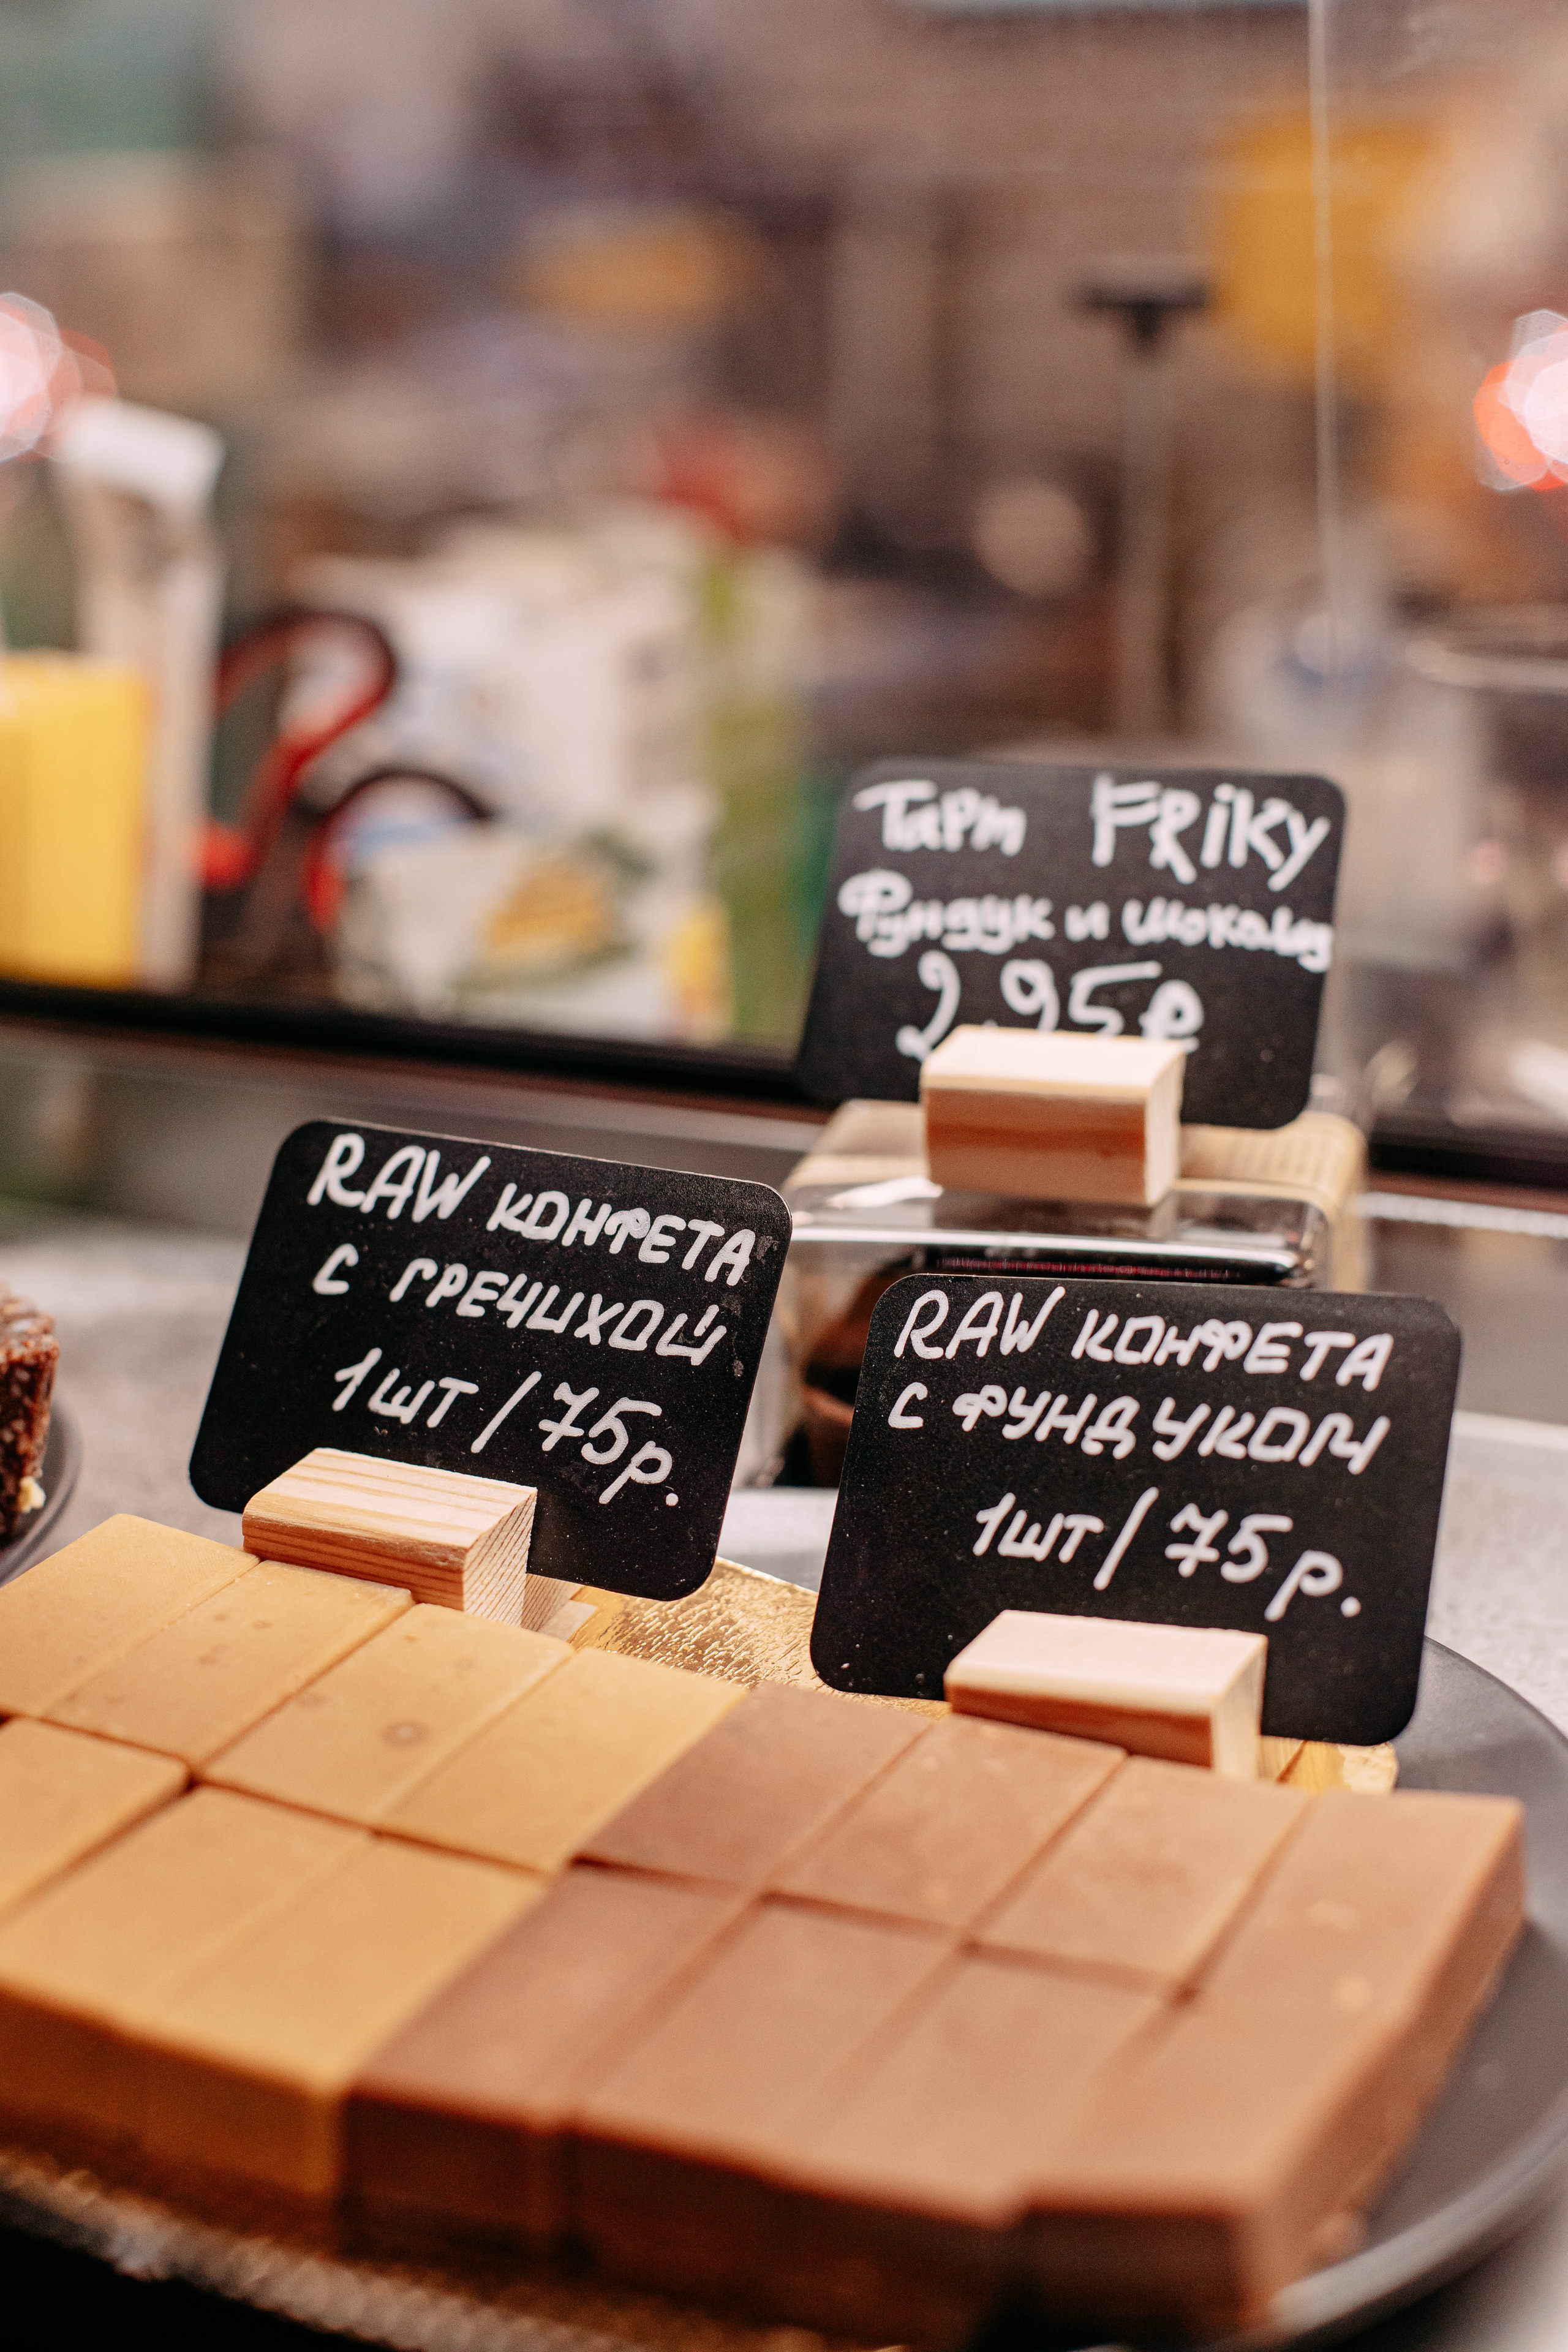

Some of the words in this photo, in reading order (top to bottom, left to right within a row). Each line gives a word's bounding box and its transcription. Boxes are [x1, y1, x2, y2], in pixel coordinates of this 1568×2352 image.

[1065, 902, 1110, 941] и
[308, 1134, 491, 1223] RAW
[486, 1183, 756, 1286] КОНФЕТА
[390, 1259, 727, 1366] ГРЕЧИХОЙ
[894, 1286, 1066, 1360] RAW
[1071, 1309, 1394, 1392] КОНФЕТА
